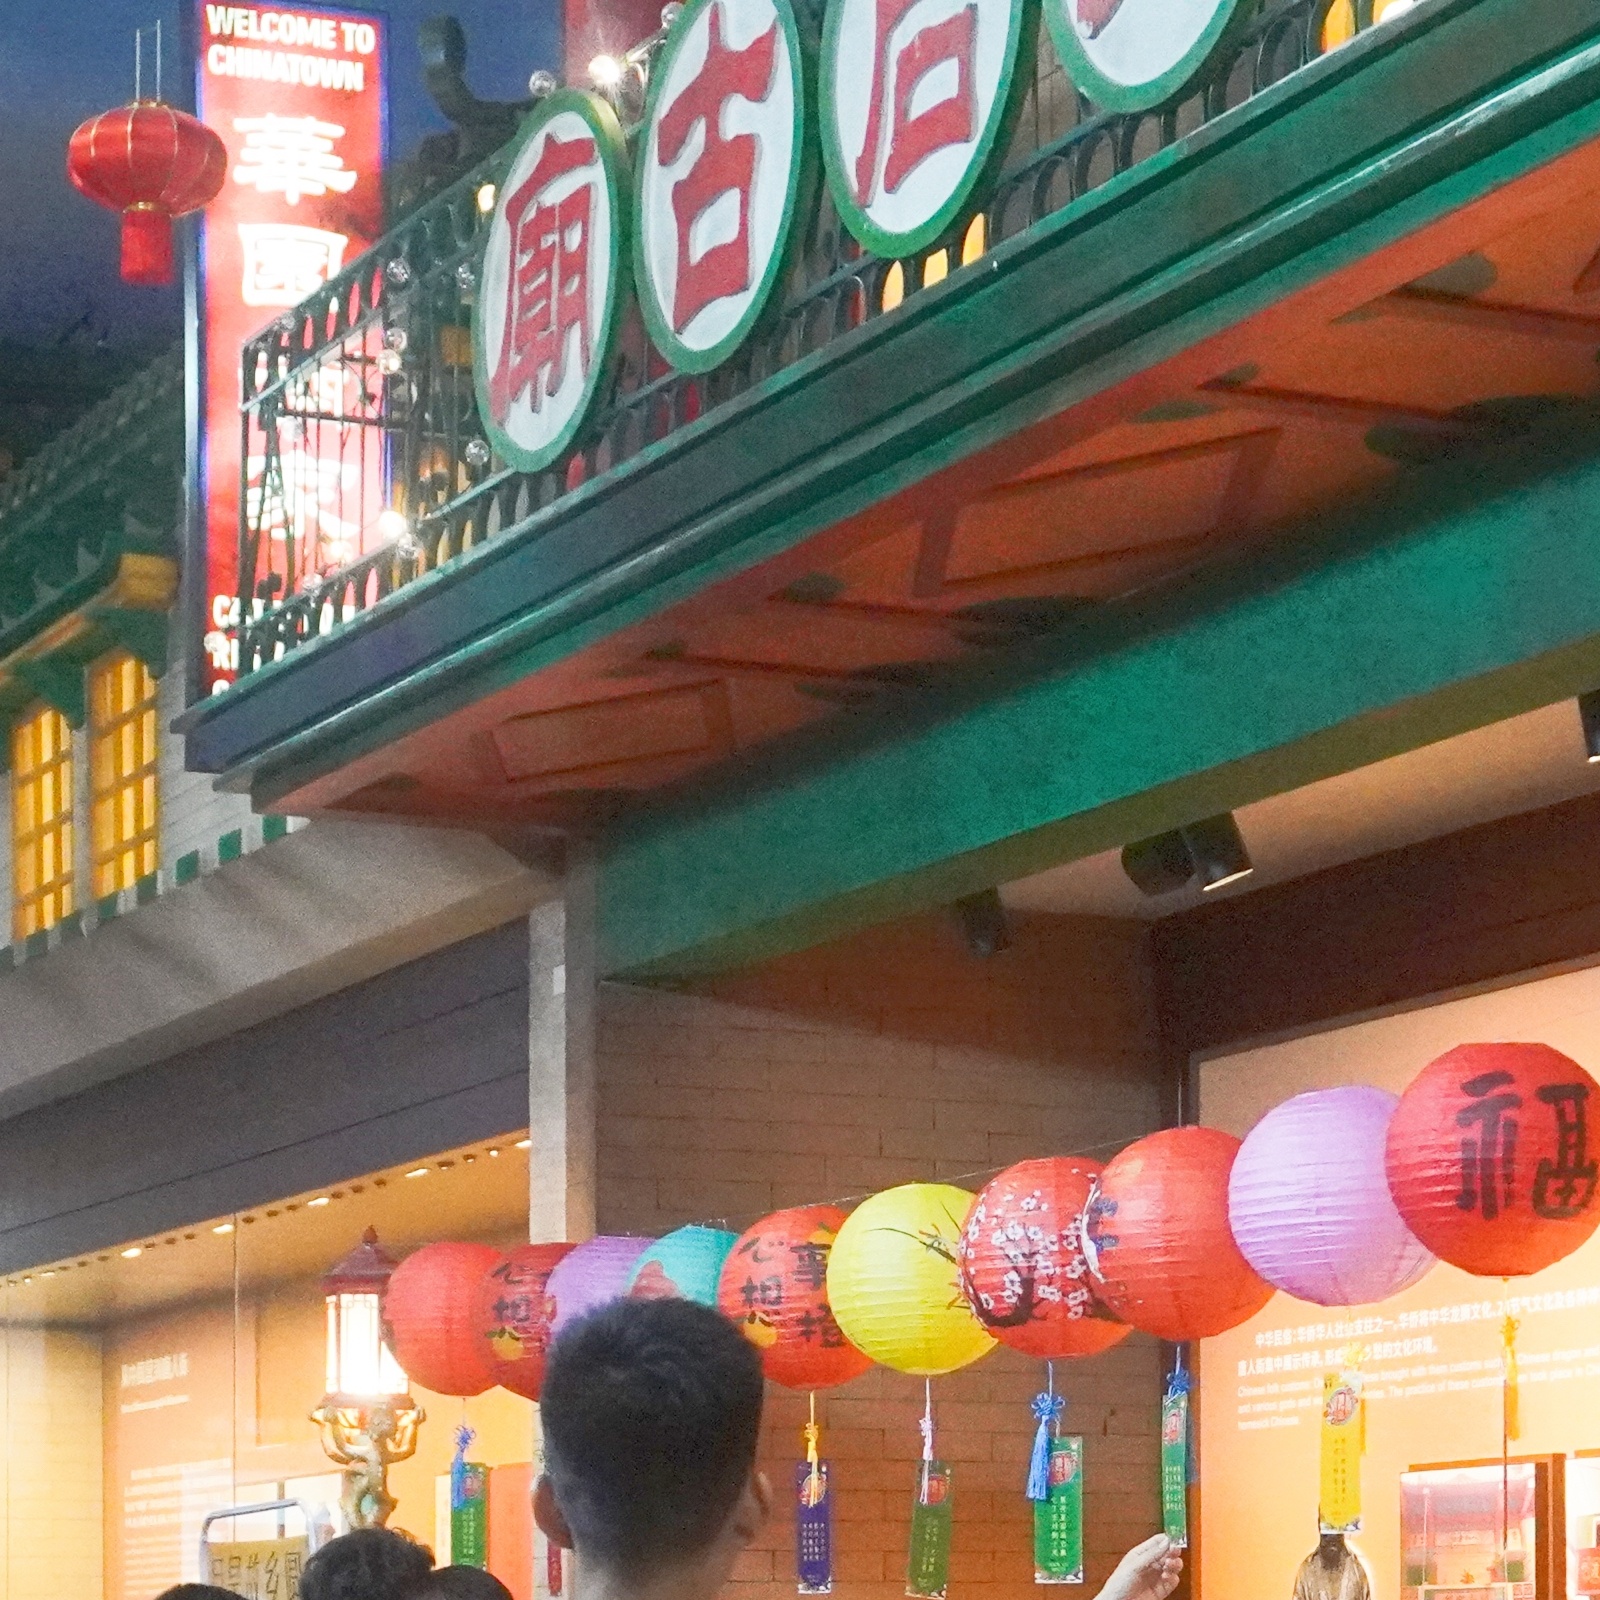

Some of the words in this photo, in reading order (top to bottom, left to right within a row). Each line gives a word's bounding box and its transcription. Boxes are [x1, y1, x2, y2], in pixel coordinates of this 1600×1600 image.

[206, 5, 338, 50] WELCOME
[340, 21, 376, 54] TO
[207, 45, 364, 92] CHINATOWN
